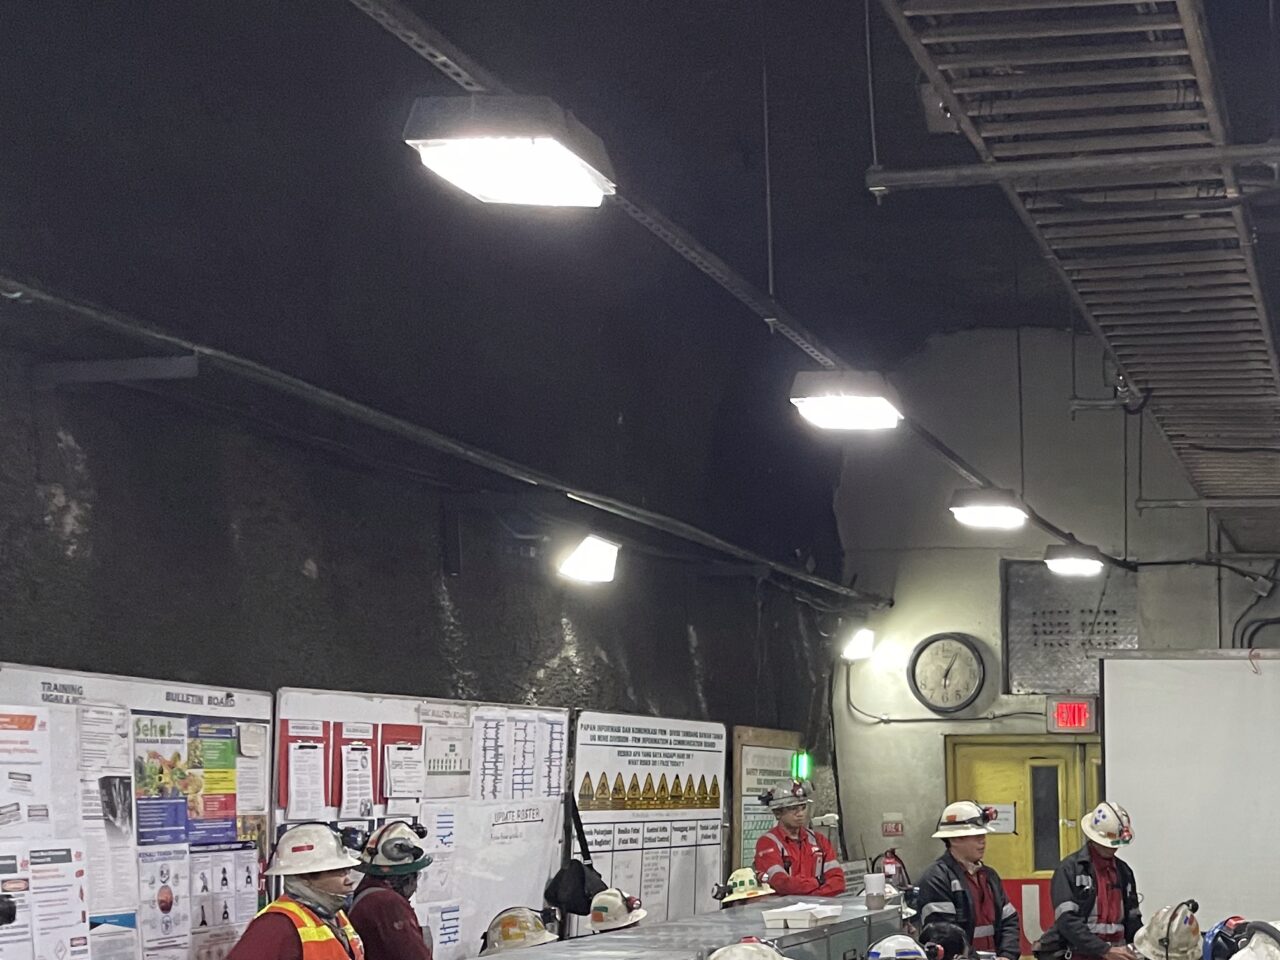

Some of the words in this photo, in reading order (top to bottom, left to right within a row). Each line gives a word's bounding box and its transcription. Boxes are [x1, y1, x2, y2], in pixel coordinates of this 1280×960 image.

[41, 682, 83, 696] TRAINING
[166, 692, 204, 705] BULLETIN
[1058, 703, 1087, 728] EXIT
